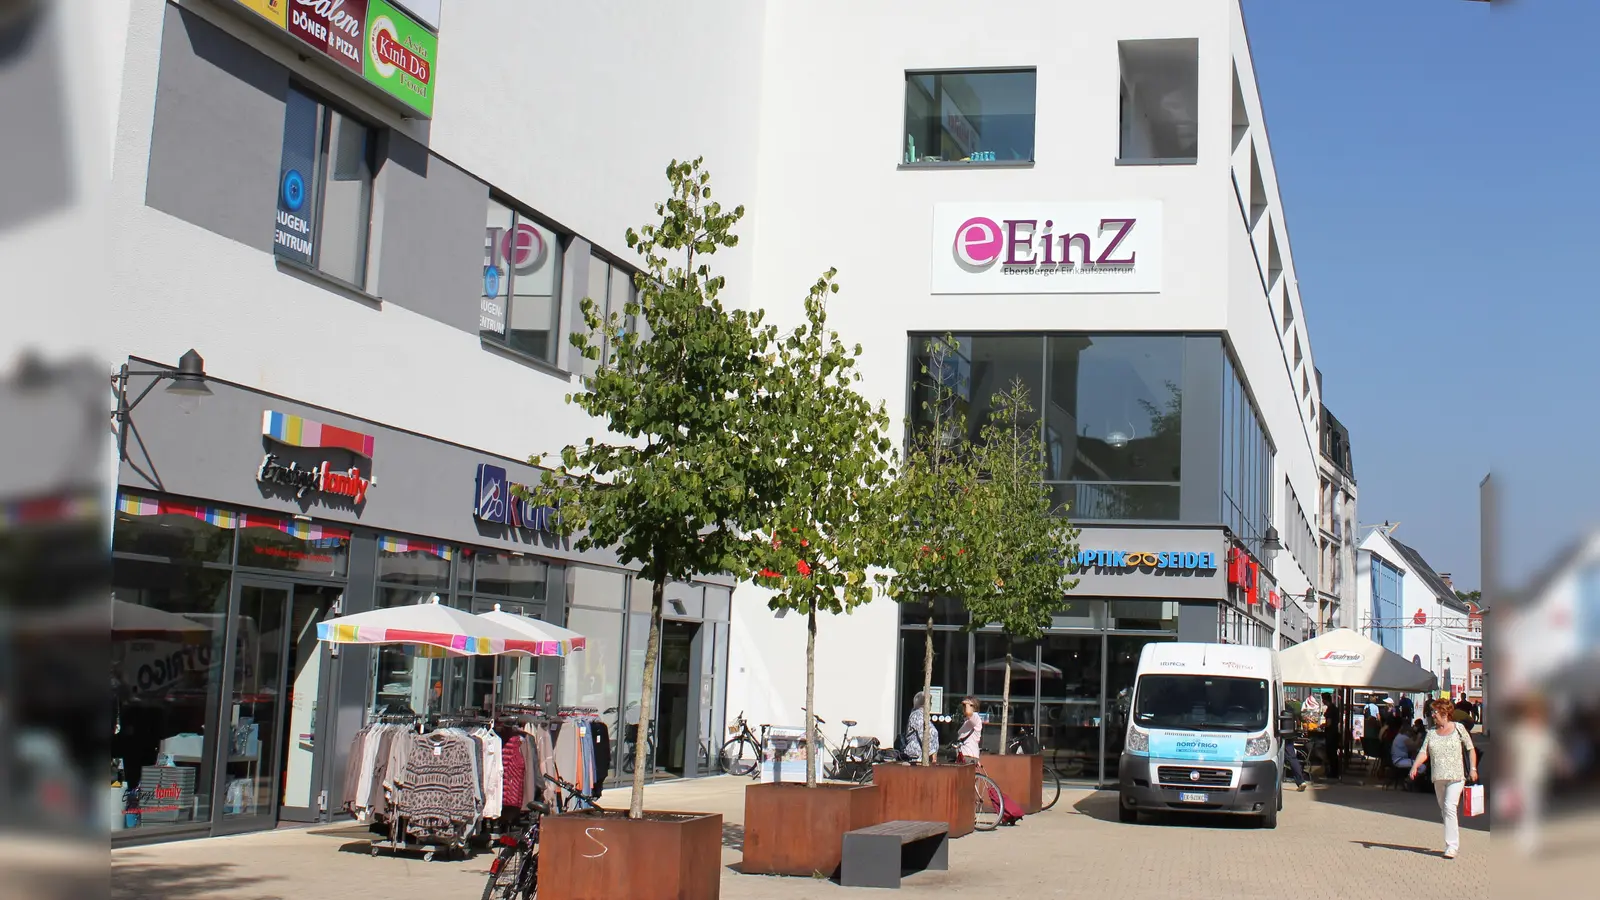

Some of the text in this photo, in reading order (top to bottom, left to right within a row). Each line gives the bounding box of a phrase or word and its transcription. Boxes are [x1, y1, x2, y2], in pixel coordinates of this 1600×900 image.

[292, 10, 326, 42] DÖNER
[329, 32, 334, 47] &
[336, 36, 360, 63] PIZZA
[404, 36, 427, 57] Asia
[380, 36, 406, 69] Kinh
[400, 74, 427, 98] Food
[1002, 218, 1137, 265] EinZ
[1003, 266, 1136, 277] Ebersberger Einkaufszentrum
[1158, 551, 1217, 569] SEIDEL
[581, 828, 607, 858] S
